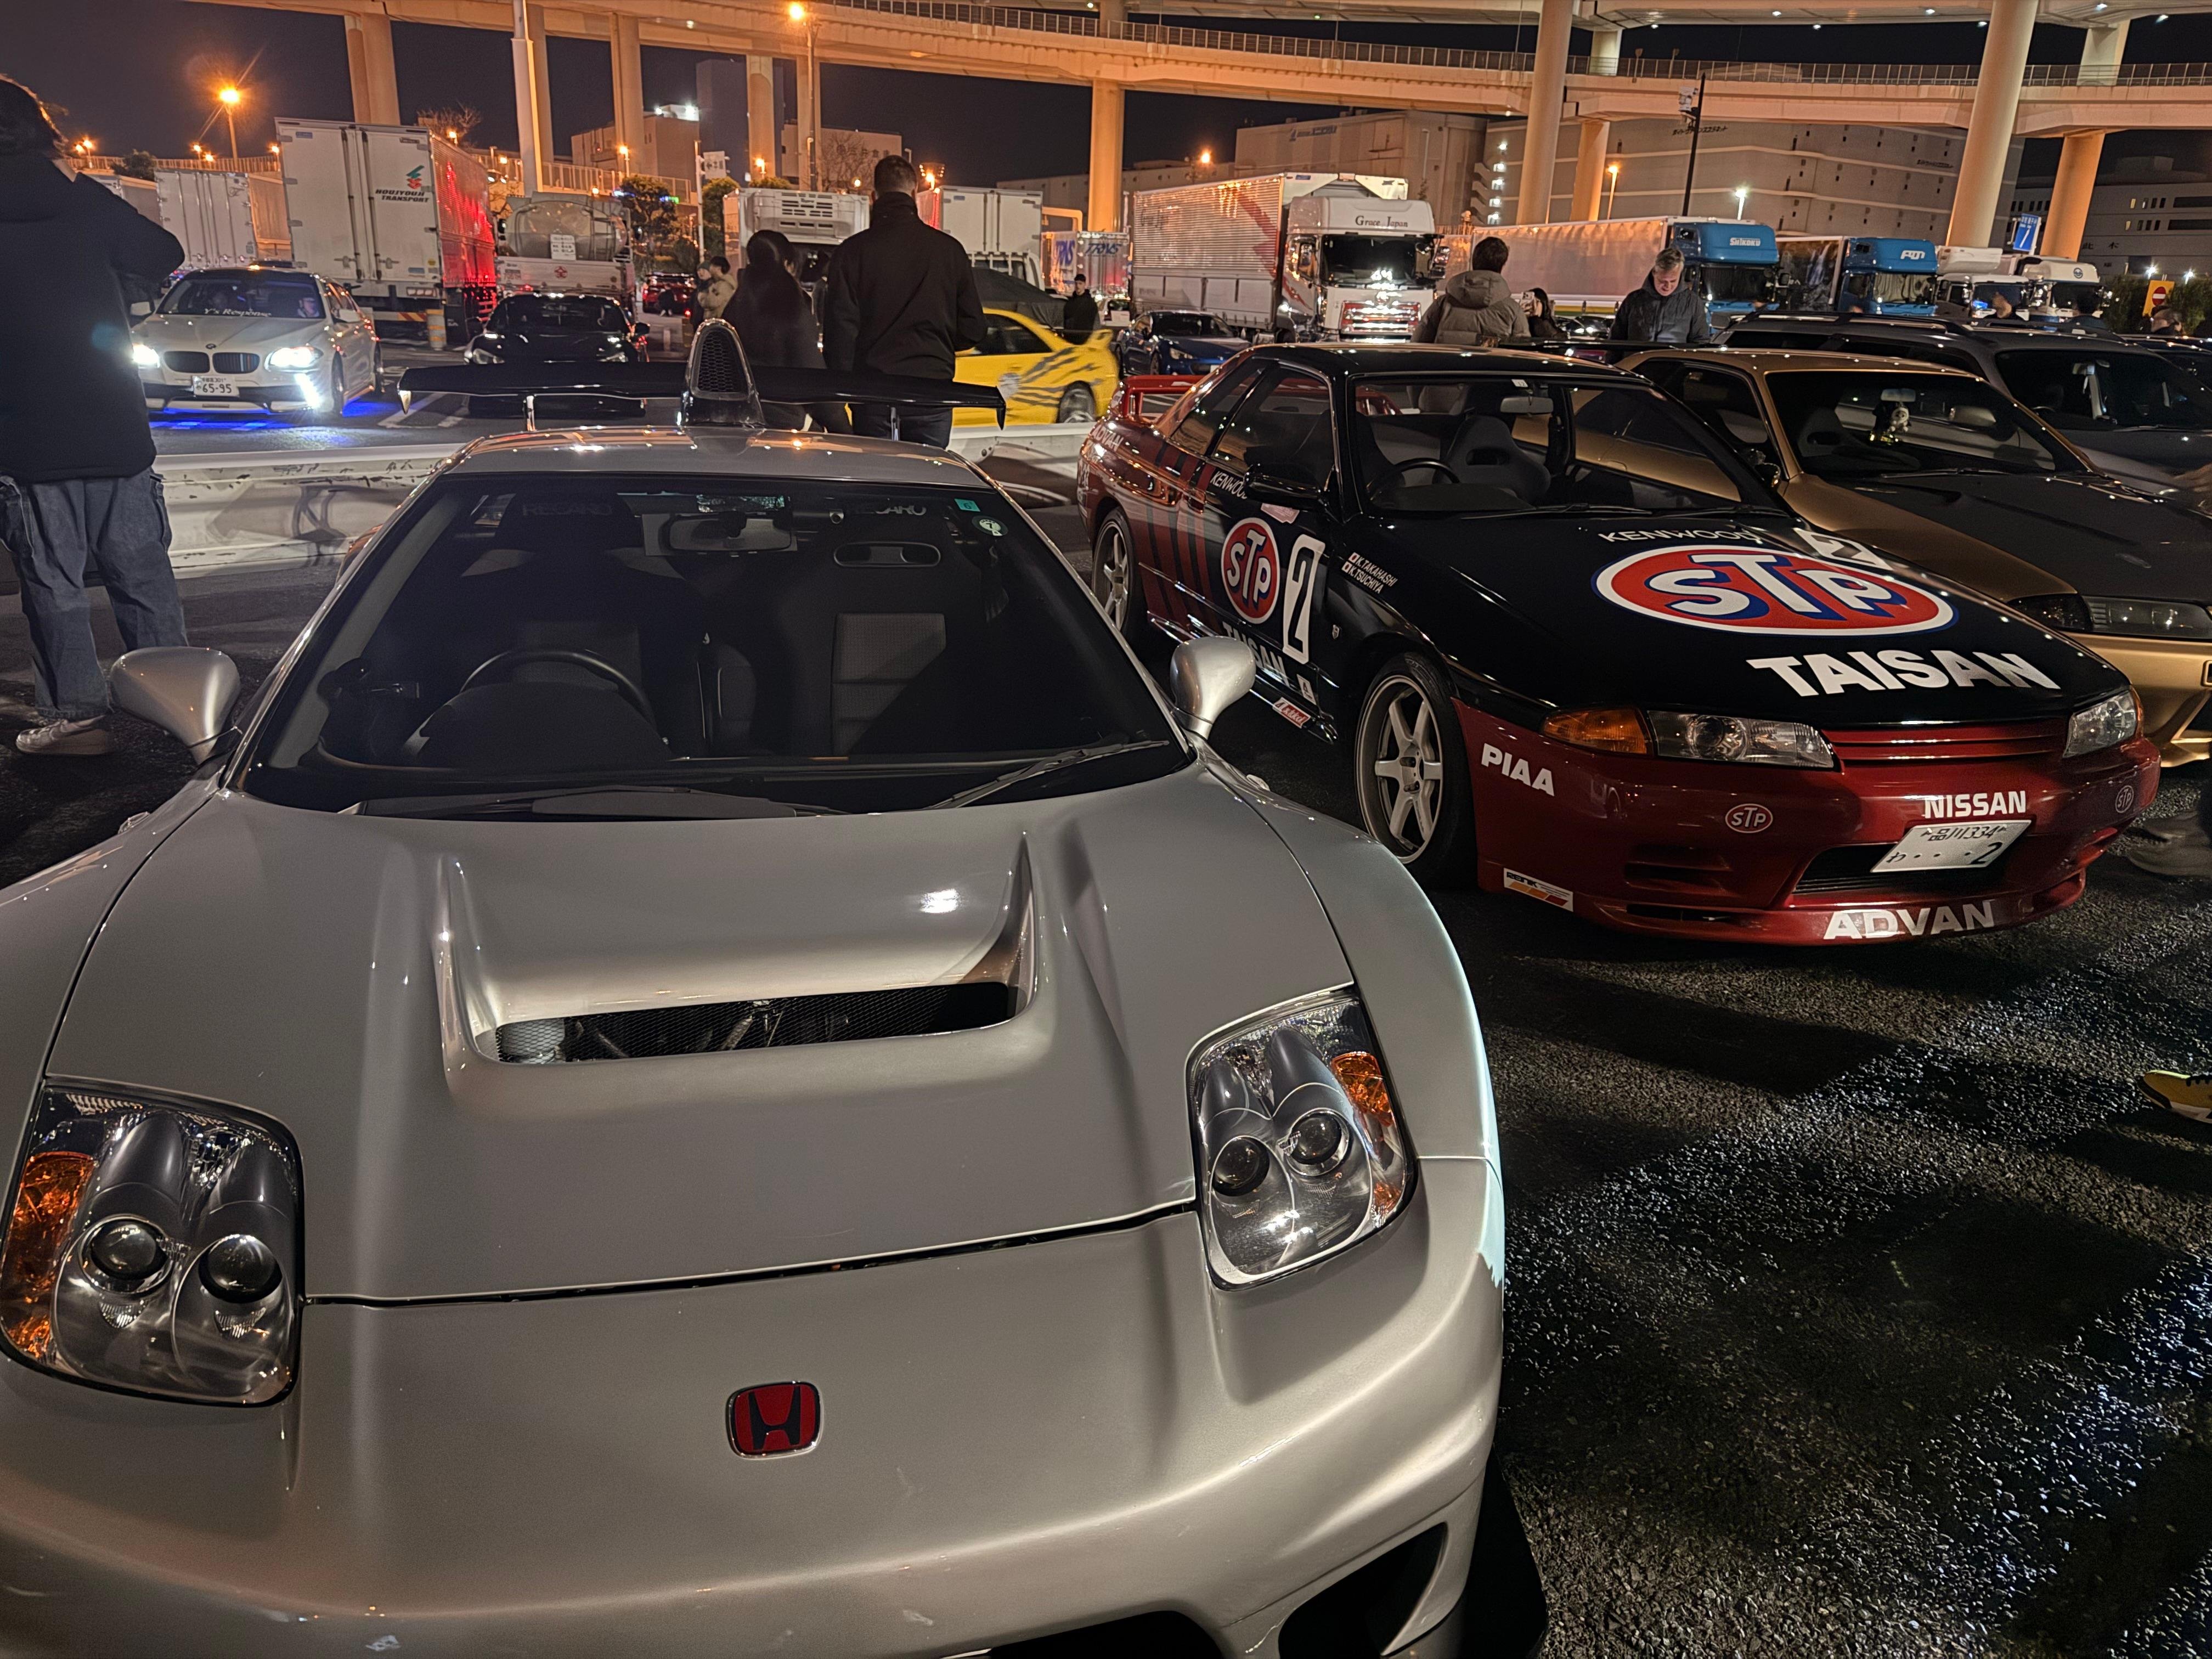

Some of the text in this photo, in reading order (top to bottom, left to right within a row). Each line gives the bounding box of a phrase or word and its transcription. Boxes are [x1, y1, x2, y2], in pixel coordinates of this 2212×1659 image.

[1355, 215, 1408, 228] Grace Japan
[222, 308, 272, 317] Response
[202, 383, 232, 394] 65-95
[1092, 424, 1124, 452] ADVAN
[1209, 471, 1248, 499] KENWOO
[1598, 530, 1762, 542] KENWOOD
[1227, 529, 1272, 606] STP
[1647, 553, 1896, 617] STP
[1288, 546, 1314, 653] 2
[1746, 650, 2061, 696] TAISAN
[1481, 743, 1555, 796] PIAA
[1925, 790, 2027, 819] NISSAN
[2118, 788, 2131, 808] STP
[1731, 807, 1766, 828] STP
[1886, 852, 1907, 864] わ
[1823, 900, 1994, 940] ADVAN
